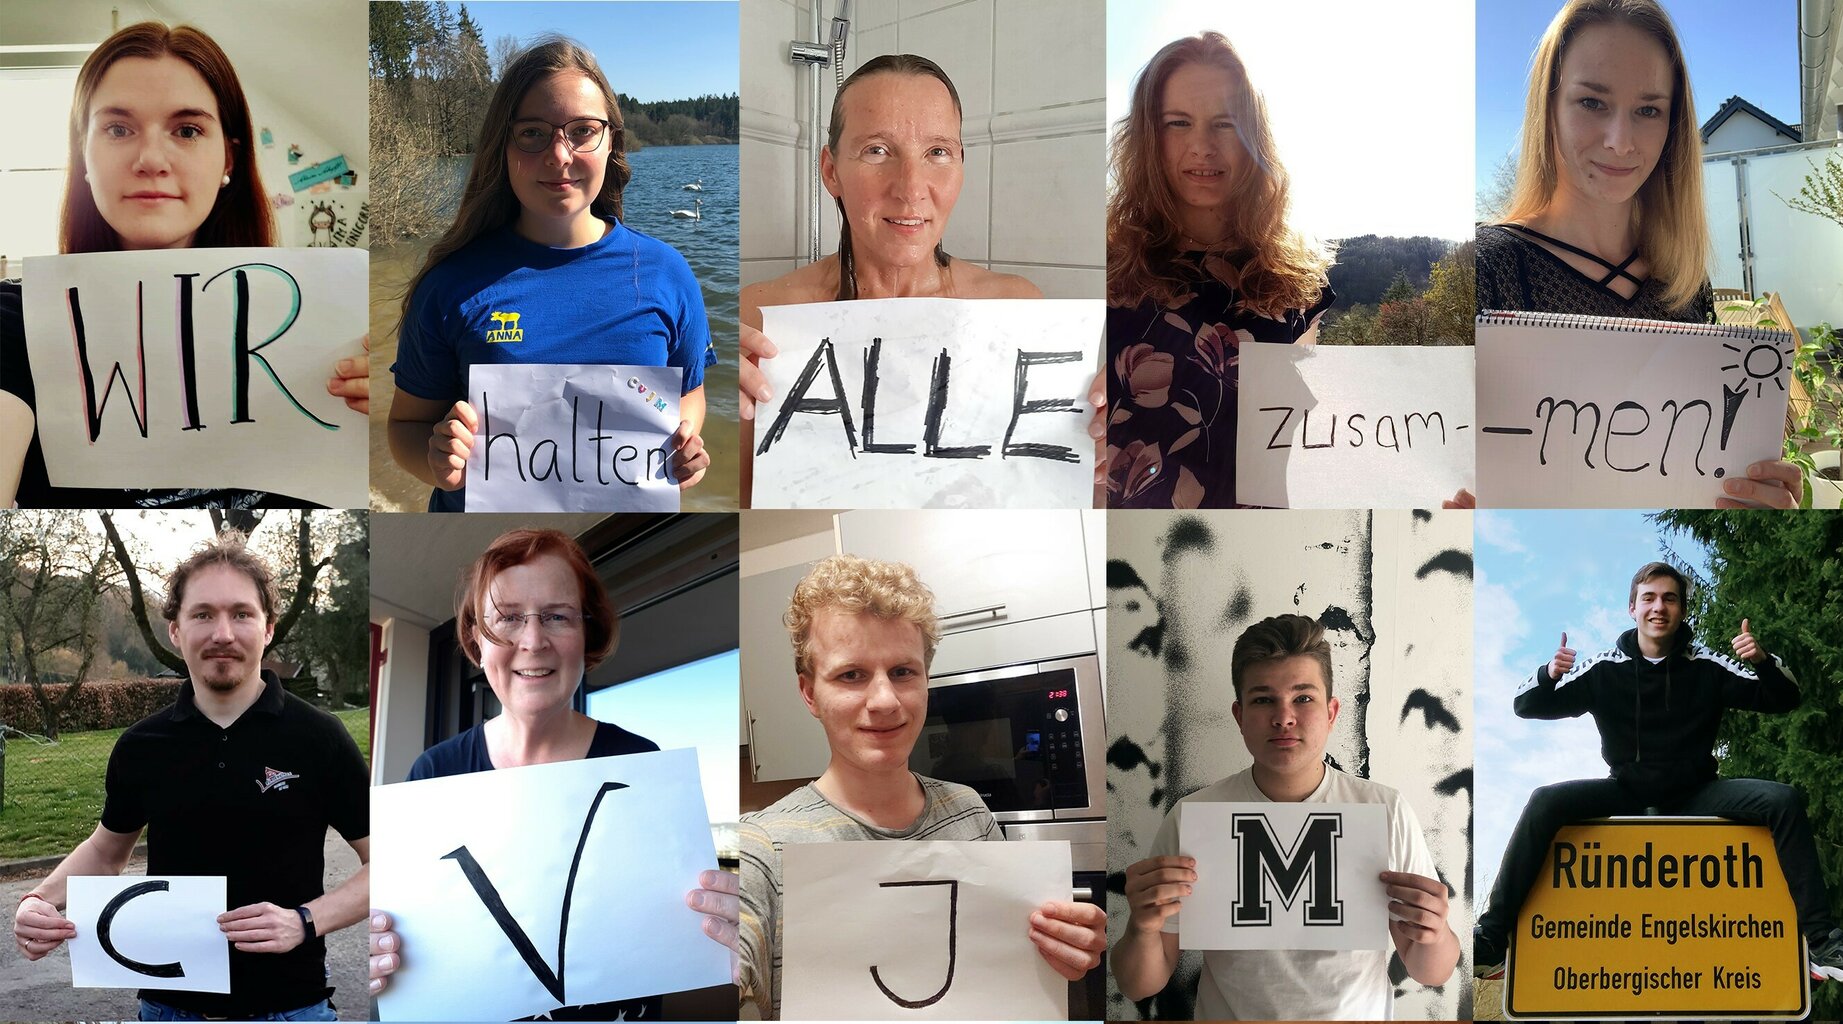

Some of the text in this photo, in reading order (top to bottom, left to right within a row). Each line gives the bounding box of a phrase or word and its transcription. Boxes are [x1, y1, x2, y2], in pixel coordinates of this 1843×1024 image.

[67, 262, 339, 445] WIR
[487, 330, 522, 342] ANNA
[481, 391, 670, 486] halten
[756, 336, 1084, 464] ALLE
[440, 781, 630, 1006] V
[1231, 812, 1344, 927] M
[1552, 841, 1763, 889] Ründeroth
[96, 880, 185, 977] C
[869, 879, 958, 1010] J
[1531, 913, 1784, 945] Gemeinde Engelskirchen
[1553, 966, 1762, 995] Oberbergischer Kreis
